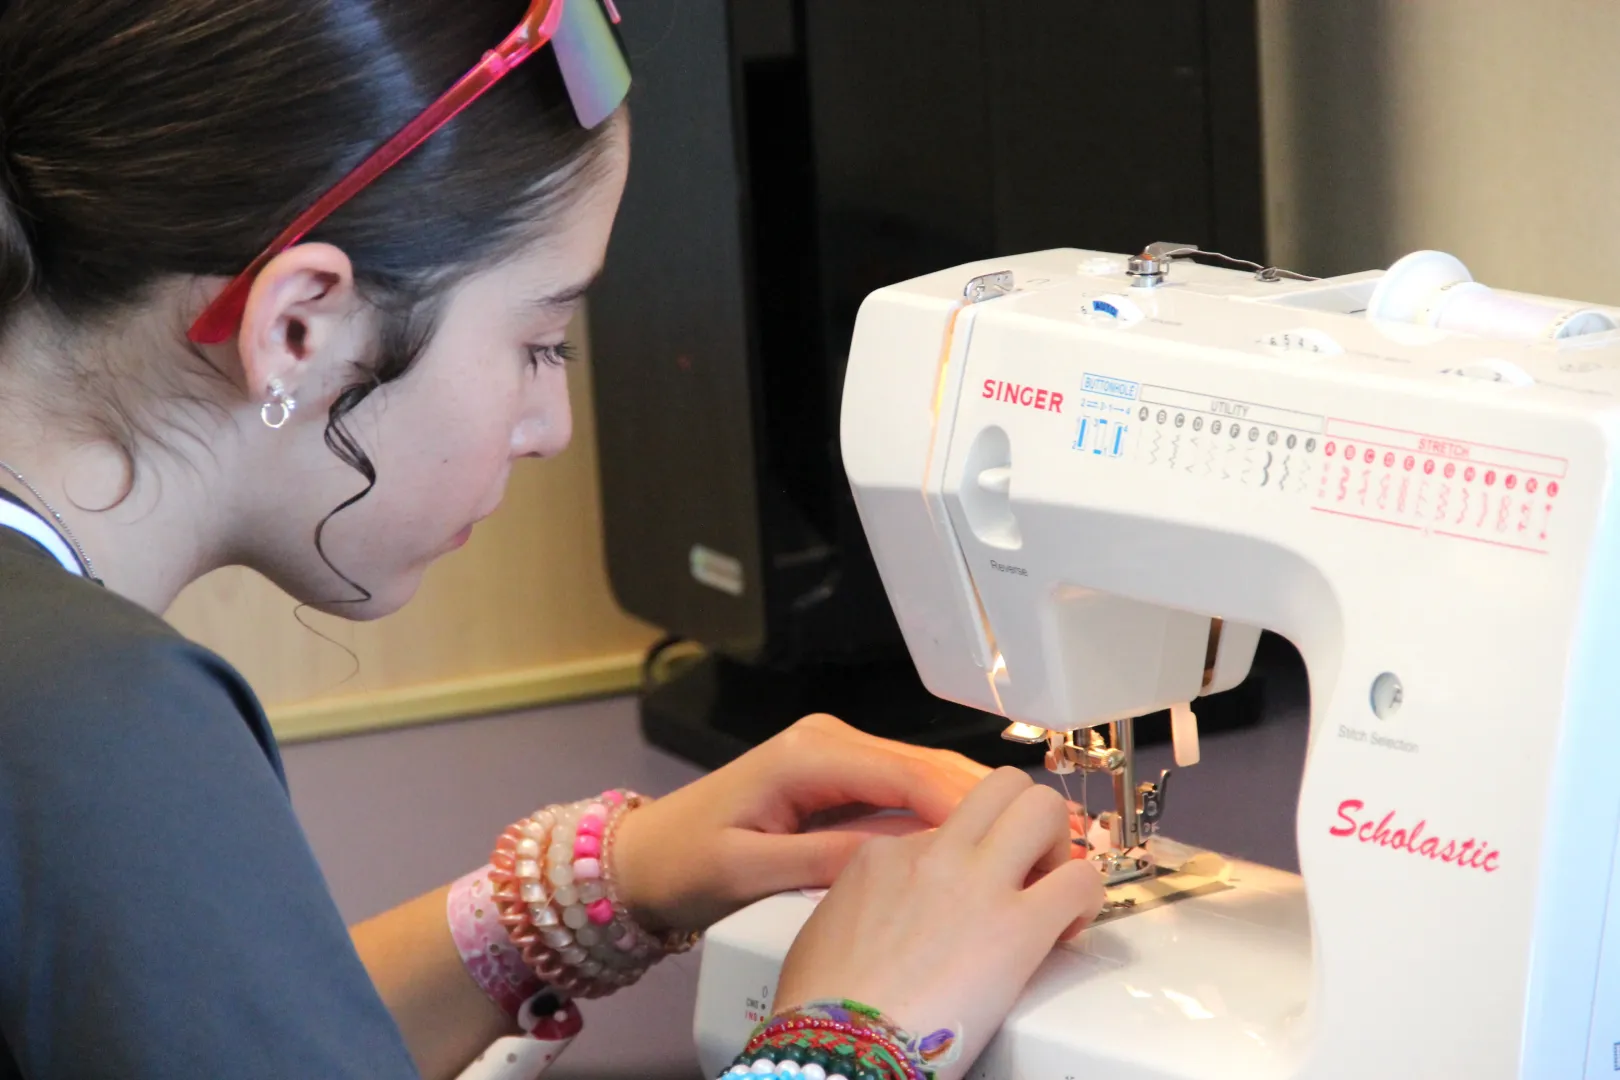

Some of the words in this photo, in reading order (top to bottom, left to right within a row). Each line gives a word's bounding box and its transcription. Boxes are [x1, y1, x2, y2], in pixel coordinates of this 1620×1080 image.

[981, 378, 1064, 414] SINGER
[1084, 376, 1135, 396] BUTTONHOLE
[1210, 400, 1251, 418] UTILITY
[1417, 437, 1470, 459] STRETCH
[989, 559, 1028, 577] Reverse
[1338, 723, 1368, 742] Stitch
[1370, 730, 1420, 753] Selection
[1329, 799, 1500, 872] Scholastic
